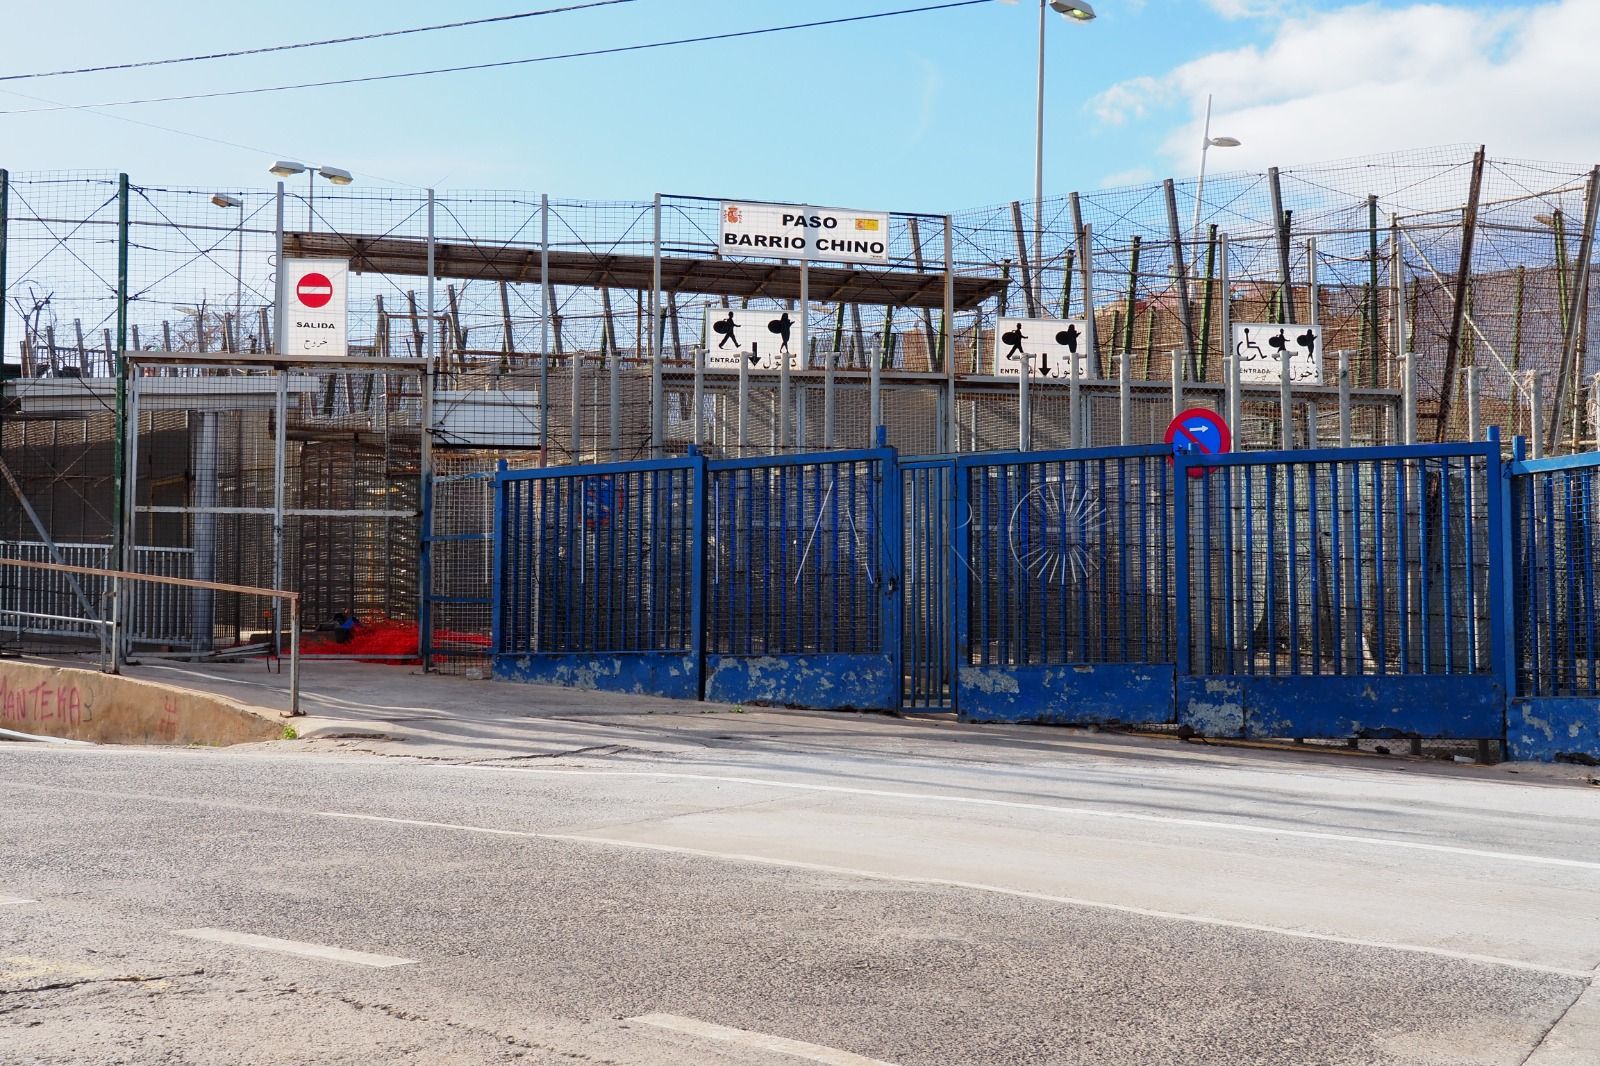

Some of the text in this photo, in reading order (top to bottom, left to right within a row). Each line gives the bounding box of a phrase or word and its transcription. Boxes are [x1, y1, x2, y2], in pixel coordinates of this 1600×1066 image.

[782, 214, 838, 229] PASO
[724, 233, 884, 254] BARRIO CHINO
[296, 321, 335, 329] SALIDA
[304, 337, 328, 350] خروج
[763, 353, 797, 370] دول
[1052, 362, 1084, 379] دول
